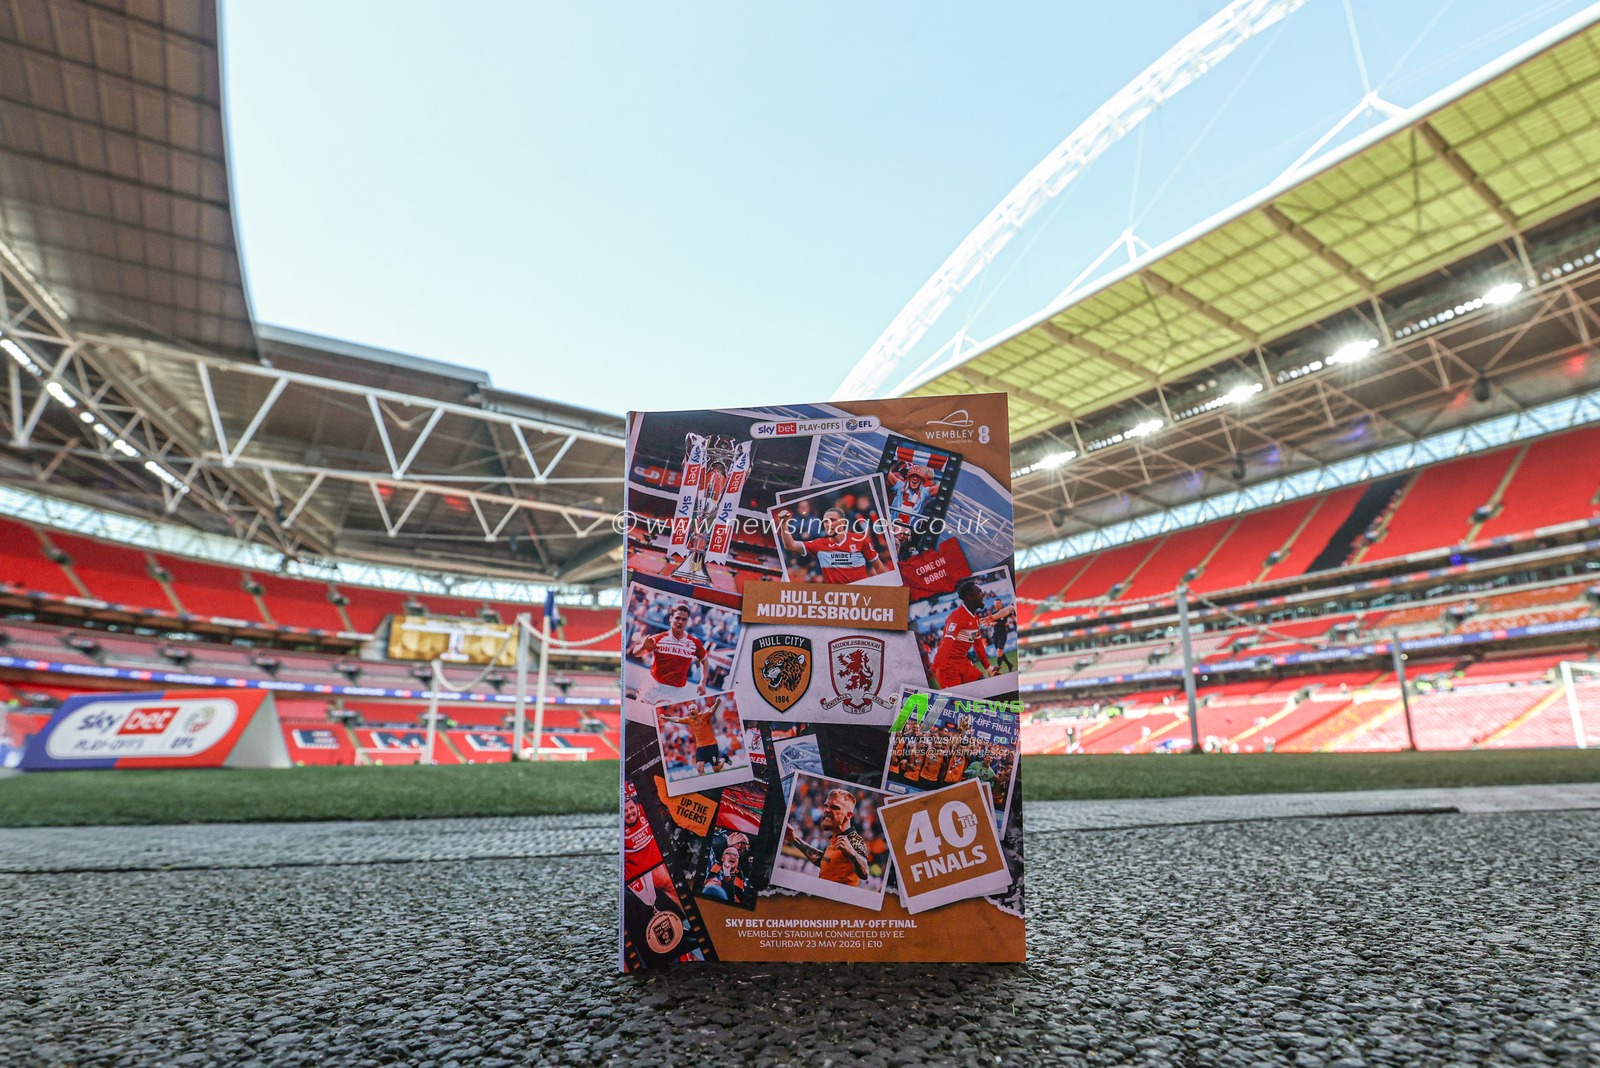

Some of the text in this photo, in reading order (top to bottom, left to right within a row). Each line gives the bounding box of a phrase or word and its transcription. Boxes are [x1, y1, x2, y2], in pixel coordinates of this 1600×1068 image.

[758, 422, 840, 435] sky bet PLAY-OFFS
[858, 420, 872, 428] EFL
[925, 430, 974, 440] WEMBLEY
[679, 496, 692, 515] sky
[718, 502, 732, 522] sky
[916, 556, 946, 576] COME ON
[924, 569, 947, 584] BORO!
[780, 590, 821, 604] HULL
[824, 592, 860, 606] CITY
[756, 604, 894, 622] MIDDLESBROUGH
[759, 636, 805, 648] HULL CITY
[832, 641, 881, 650] MIDDLESBROUGH
[127, 710, 170, 730] bet
[942, 708, 956, 718] BET
[991, 722, 1012, 734] FINAL
[680, 797, 709, 815] UP THE
[676, 806, 707, 825] TIGERS!
[910, 845, 988, 882] FINALS
[726, 918, 917, 928] SKY BET CHAMPIONSHIP PLAY-OFF FINAL
[738, 930, 782, 938] WEMBLEY
[784, 930, 823, 938] STADIUM
[760, 940, 883, 948] SATURDAY 23 MAY 2026 £10
